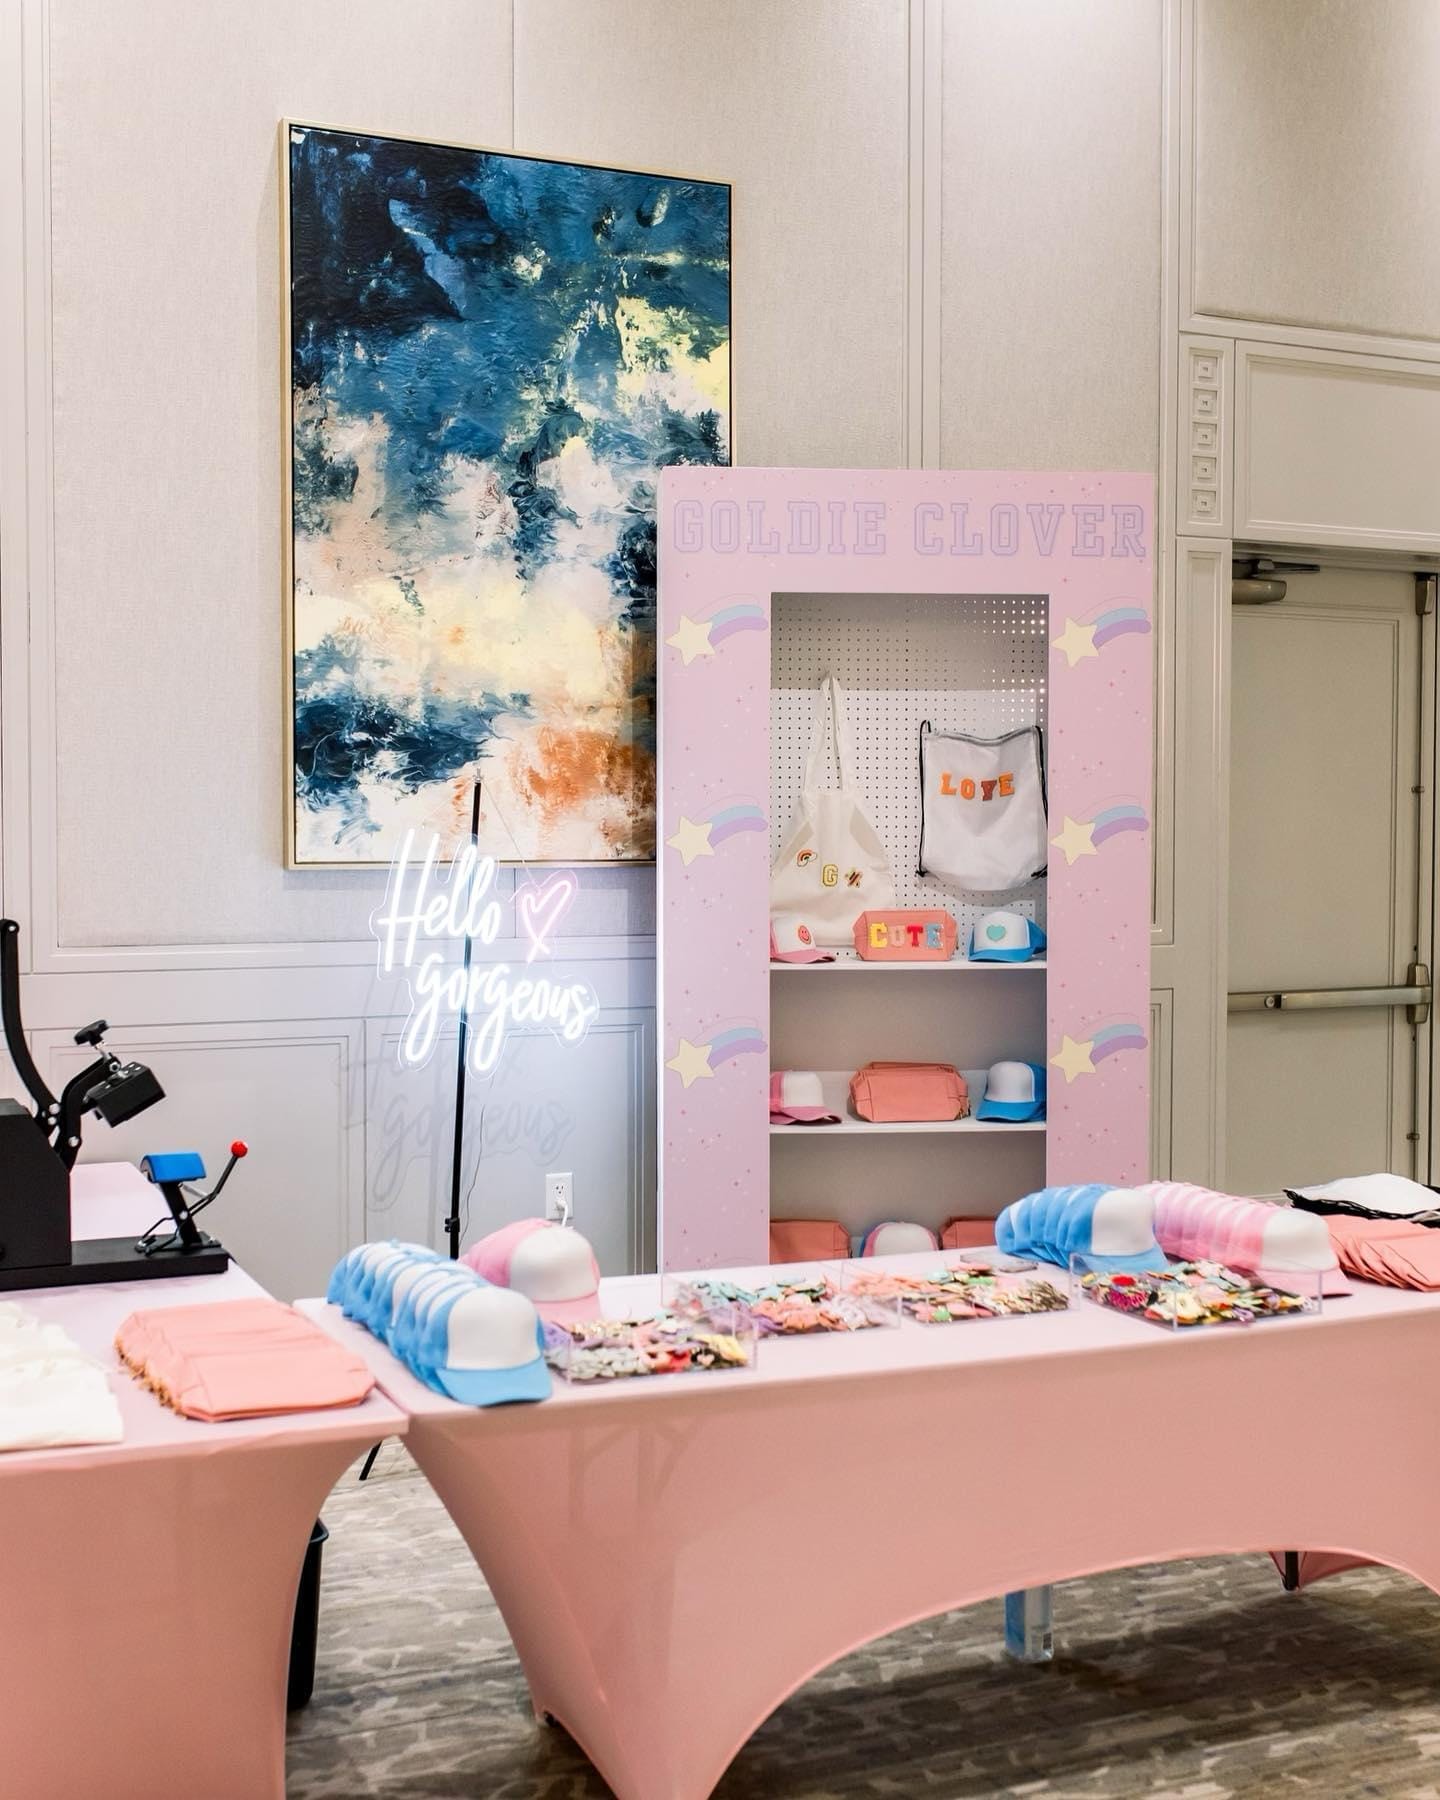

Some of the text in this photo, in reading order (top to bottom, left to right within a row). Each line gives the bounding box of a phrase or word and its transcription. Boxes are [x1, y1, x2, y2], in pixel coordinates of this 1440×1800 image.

[674, 500, 1147, 557] GOLDIE CLOVER
[378, 828, 500, 972] Hello
[822, 864, 839, 887] G
[869, 922, 944, 949] CUTE
[405, 953, 597, 1071] gorgeous
